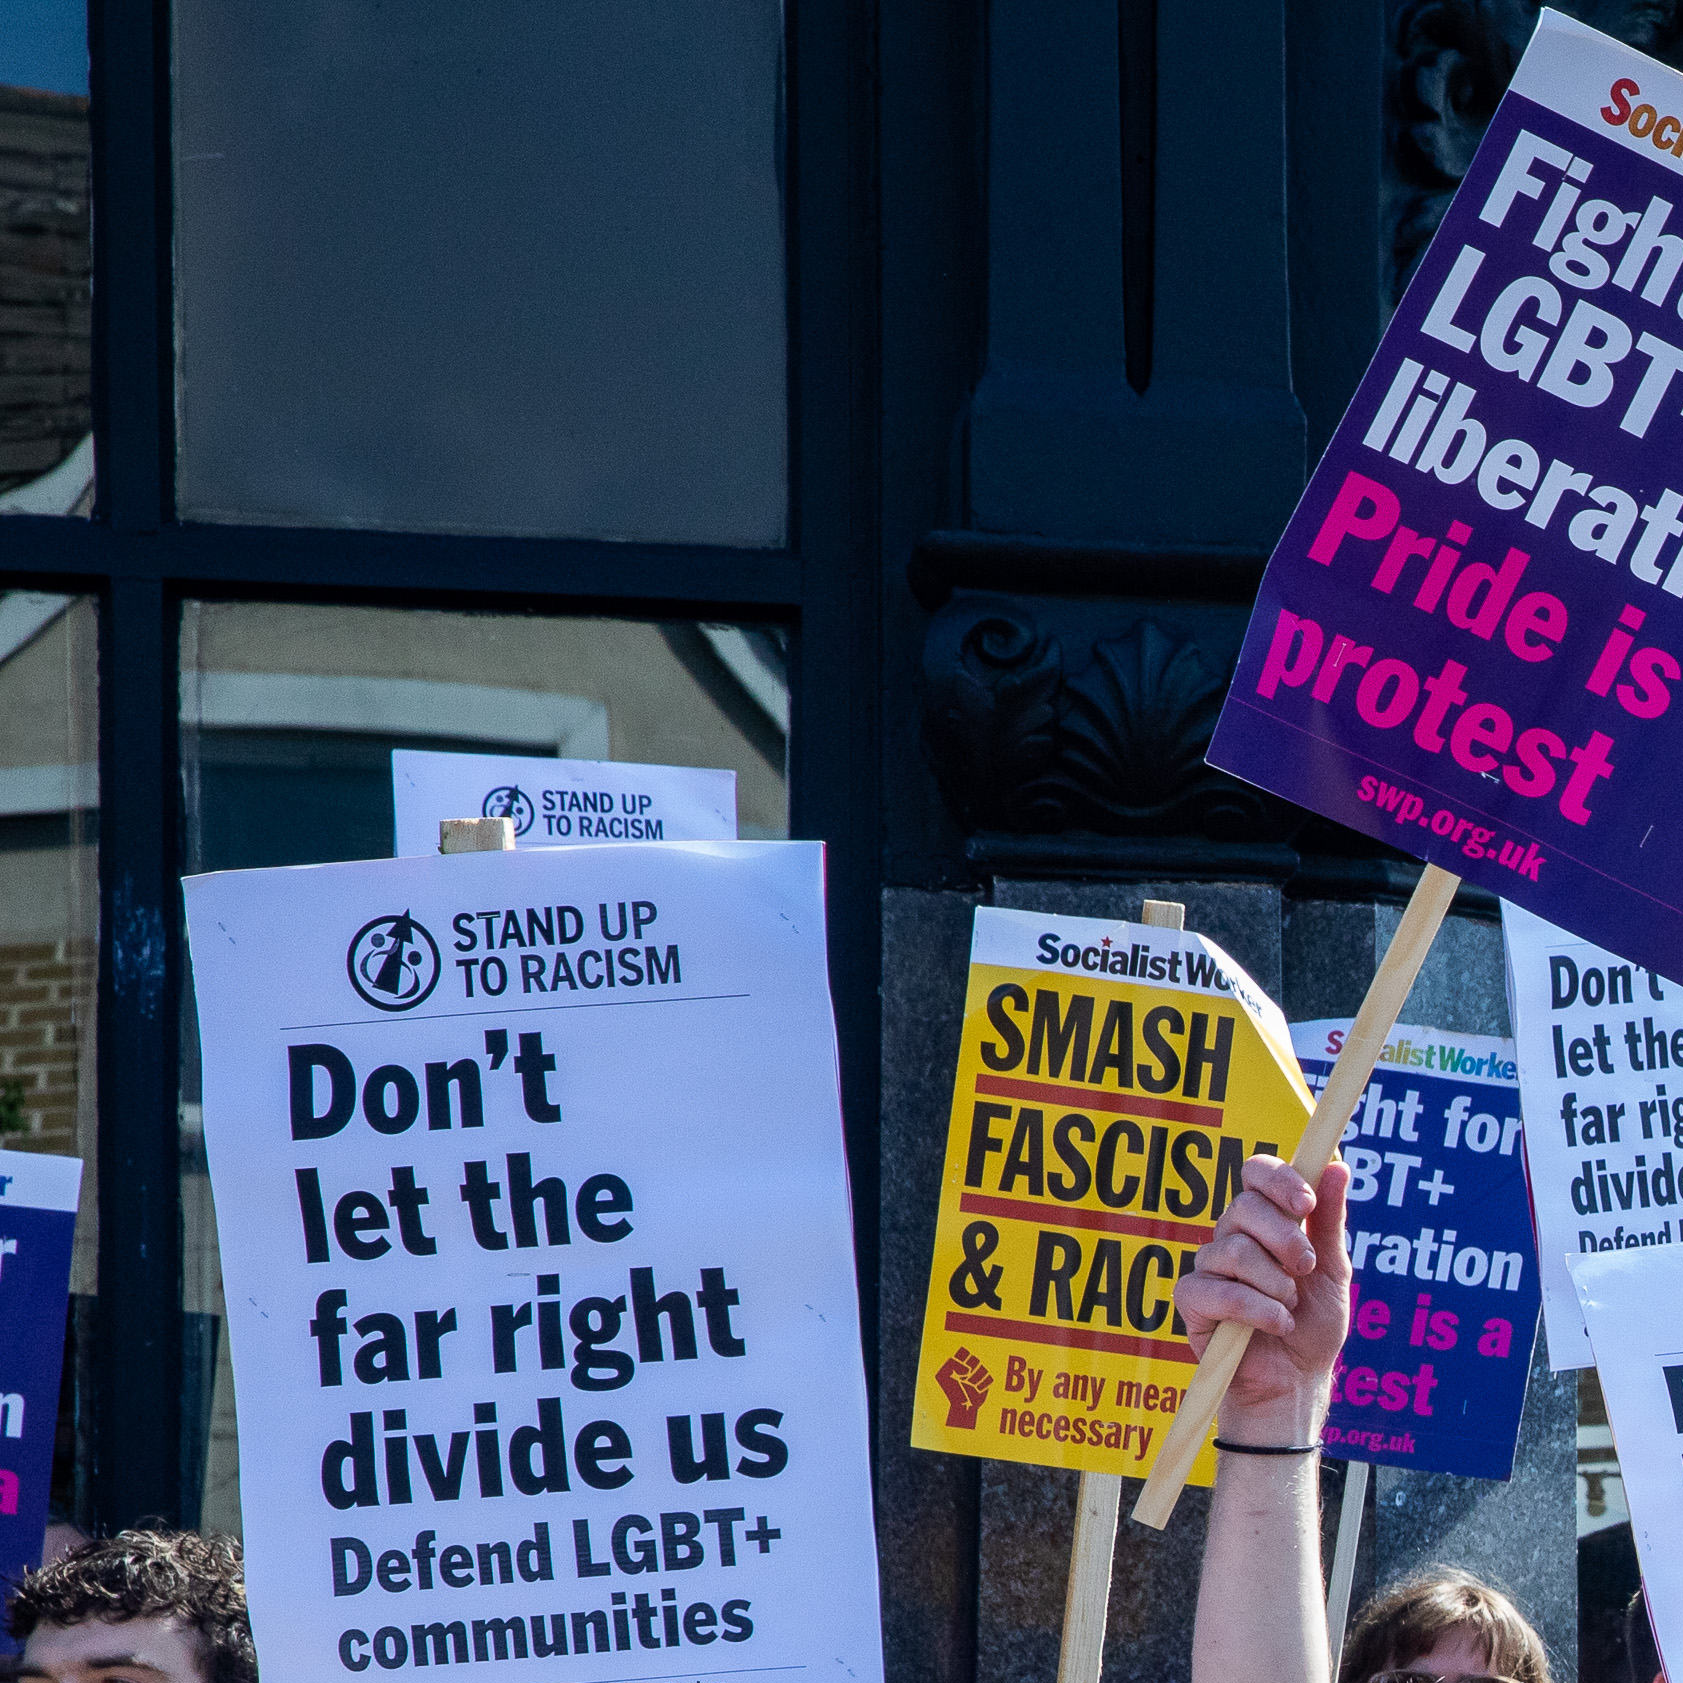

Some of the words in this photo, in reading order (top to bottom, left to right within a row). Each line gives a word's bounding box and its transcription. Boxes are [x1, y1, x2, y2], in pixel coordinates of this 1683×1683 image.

[1305, 469, 1569, 663] Pride
[1585, 605, 1683, 718] is
[1256, 607, 1616, 827] protest
[543, 790, 613, 813] STAND
[622, 794, 651, 815] UP
[543, 815, 571, 836] TO
[579, 816, 663, 840] RACISM
[1355, 772, 1549, 883] swp.org.uk
[453, 906, 583, 952] STAND
[599, 901, 657, 941] UP
[456, 957, 507, 997] TO
[521, 945, 681, 993] RACISM
[981, 983, 1235, 1102] SMASH
[1553, 1024, 1614, 1078] let
[288, 1029, 561, 1140] Don't
[1444, 1096, 1523, 1155] for
[1561, 1093, 1625, 1147] far
[295, 1166, 437, 1263] let
[460, 1152, 633, 1250] the
[1343, 1145, 1454, 1207] BT+
[949, 1221, 1003, 1310] &
[1029, 1230, 1192, 1337] RACI
[1345, 1228, 1523, 1291] ration
[310, 1289, 457, 1387] far
[491, 1267, 745, 1391] right
[1409, 1293, 1459, 1351] is
[1477, 1318, 1513, 1358] a
[1005, 1355, 1044, 1404] By
[1052, 1371, 1106, 1412] any
[1115, 1379, 1187, 1414] mea
[322, 1397, 634, 1509] divide
[667, 1409, 788, 1484] us
[999, 1408, 1154, 1461] necessary
[331, 1522, 554, 1596] Defend
[573, 1507, 781, 1578] LGBT+
[339, 1592, 753, 1671] communities
